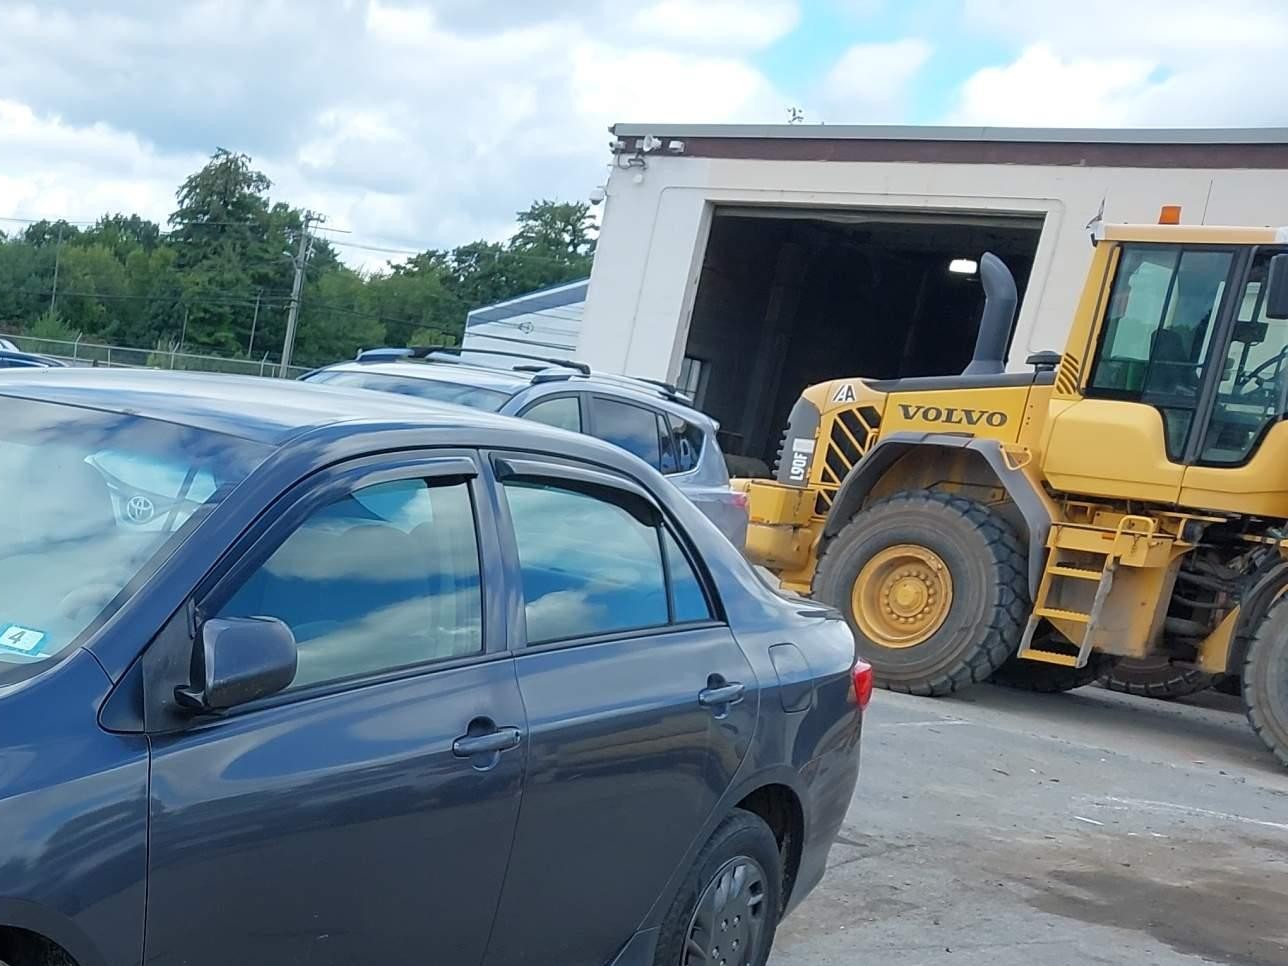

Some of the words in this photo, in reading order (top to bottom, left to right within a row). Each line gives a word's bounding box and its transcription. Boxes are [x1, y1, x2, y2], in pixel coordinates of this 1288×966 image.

[898, 404, 1008, 427] VOLVO
[789, 452, 808, 480] L90F
[8, 631, 26, 644] 4
